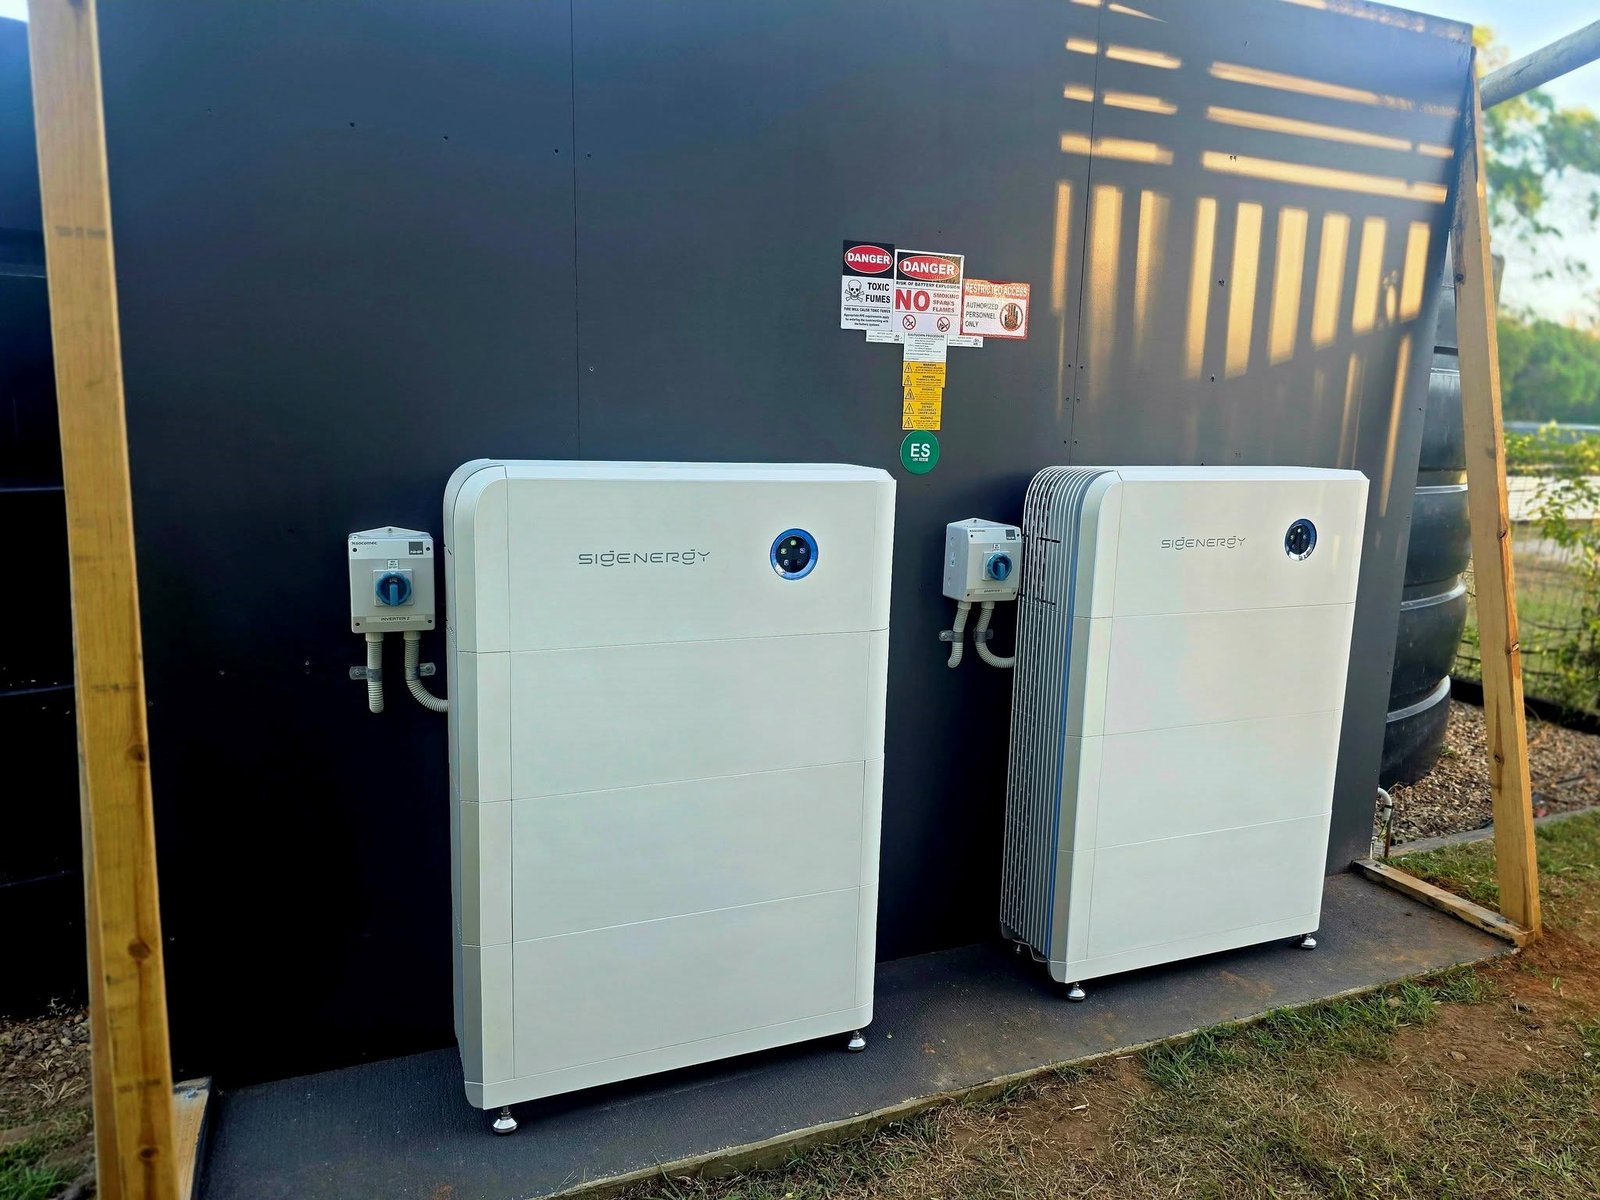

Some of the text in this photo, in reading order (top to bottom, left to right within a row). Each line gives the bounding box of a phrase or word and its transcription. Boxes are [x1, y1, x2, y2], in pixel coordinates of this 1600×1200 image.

[847, 253, 890, 265] DANGER
[903, 261, 955, 275] DANGER
[867, 282, 890, 292] TOXIC
[965, 283, 1027, 297] RESTRICTED ACCESS
[865, 294, 891, 304] FUMES
[895, 289, 930, 312] NO
[966, 302, 998, 310] AUTHORIZED
[965, 311, 997, 319] PERSONNEL
[965, 320, 979, 328] ONLY
[910, 443, 931, 458] ES
